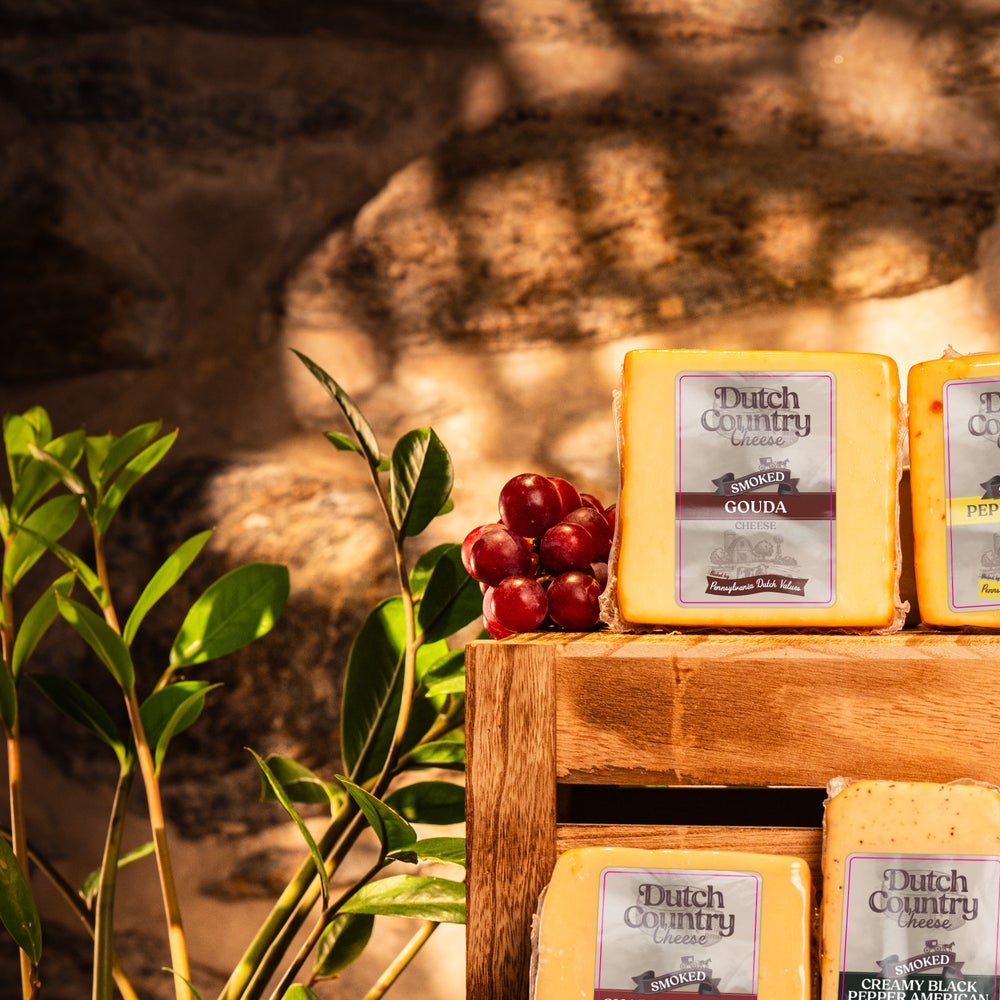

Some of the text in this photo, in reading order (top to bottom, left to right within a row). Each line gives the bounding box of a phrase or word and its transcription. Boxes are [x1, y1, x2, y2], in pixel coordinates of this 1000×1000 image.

[714, 386, 800, 409] Dutch
[701, 409, 810, 437] Country
[731, 425, 785, 446] Cheese
[731, 472, 785, 493] SMOKED
[725, 501, 787, 513] GOUDA
[735, 522, 776, 530] CHEESE
[710, 579, 801, 593] Pennsylvania Dutch Values
[884, 869, 968, 892] Dutch
[639, 883, 724, 908] Dutch
[869, 891, 978, 921] Country
[624, 906, 735, 937] Country
[898, 910, 951, 928] Cheese
[653, 925, 707, 945] Cheese
[896, 955, 950, 976] SMOKED
[651, 970, 706, 992] SMOKED
[861, 979, 977, 992] CREAMY BLACK
